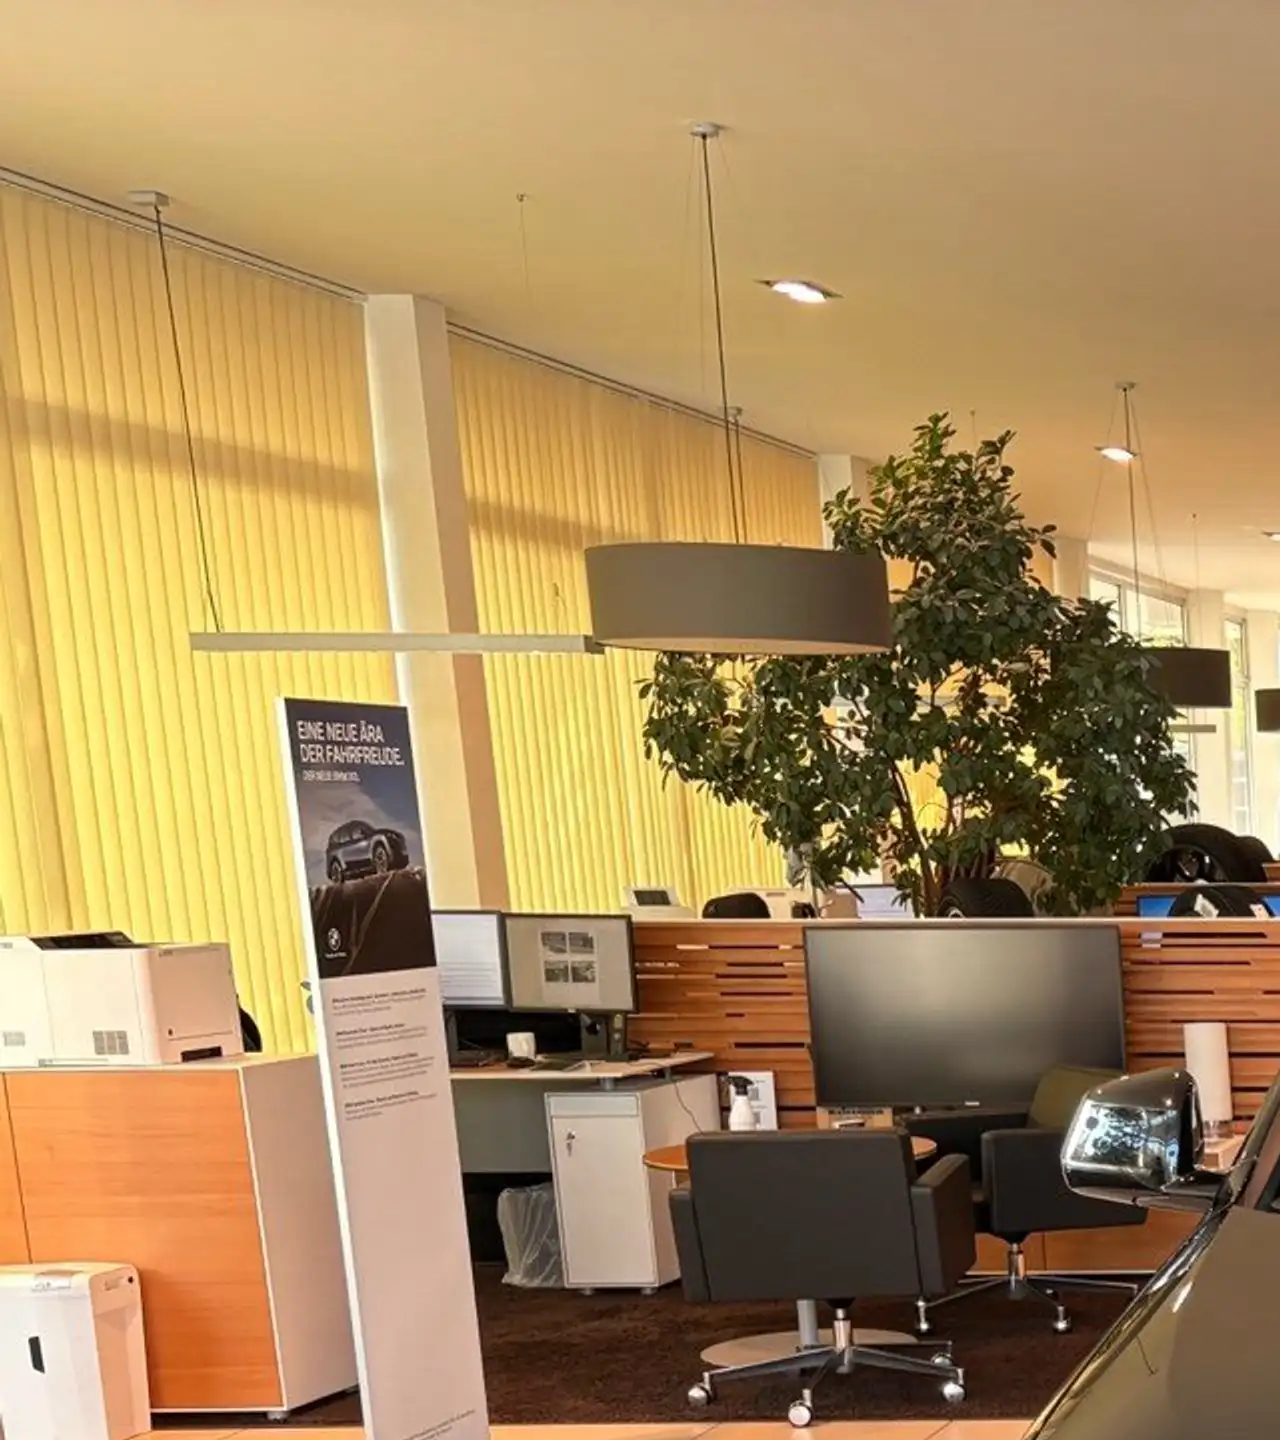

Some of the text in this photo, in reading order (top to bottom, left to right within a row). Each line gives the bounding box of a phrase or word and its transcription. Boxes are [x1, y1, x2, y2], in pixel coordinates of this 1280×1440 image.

[296, 720, 385, 743] EINE NEUE ÄRA
[300, 743, 405, 766] DER FAHRFREUDE.
